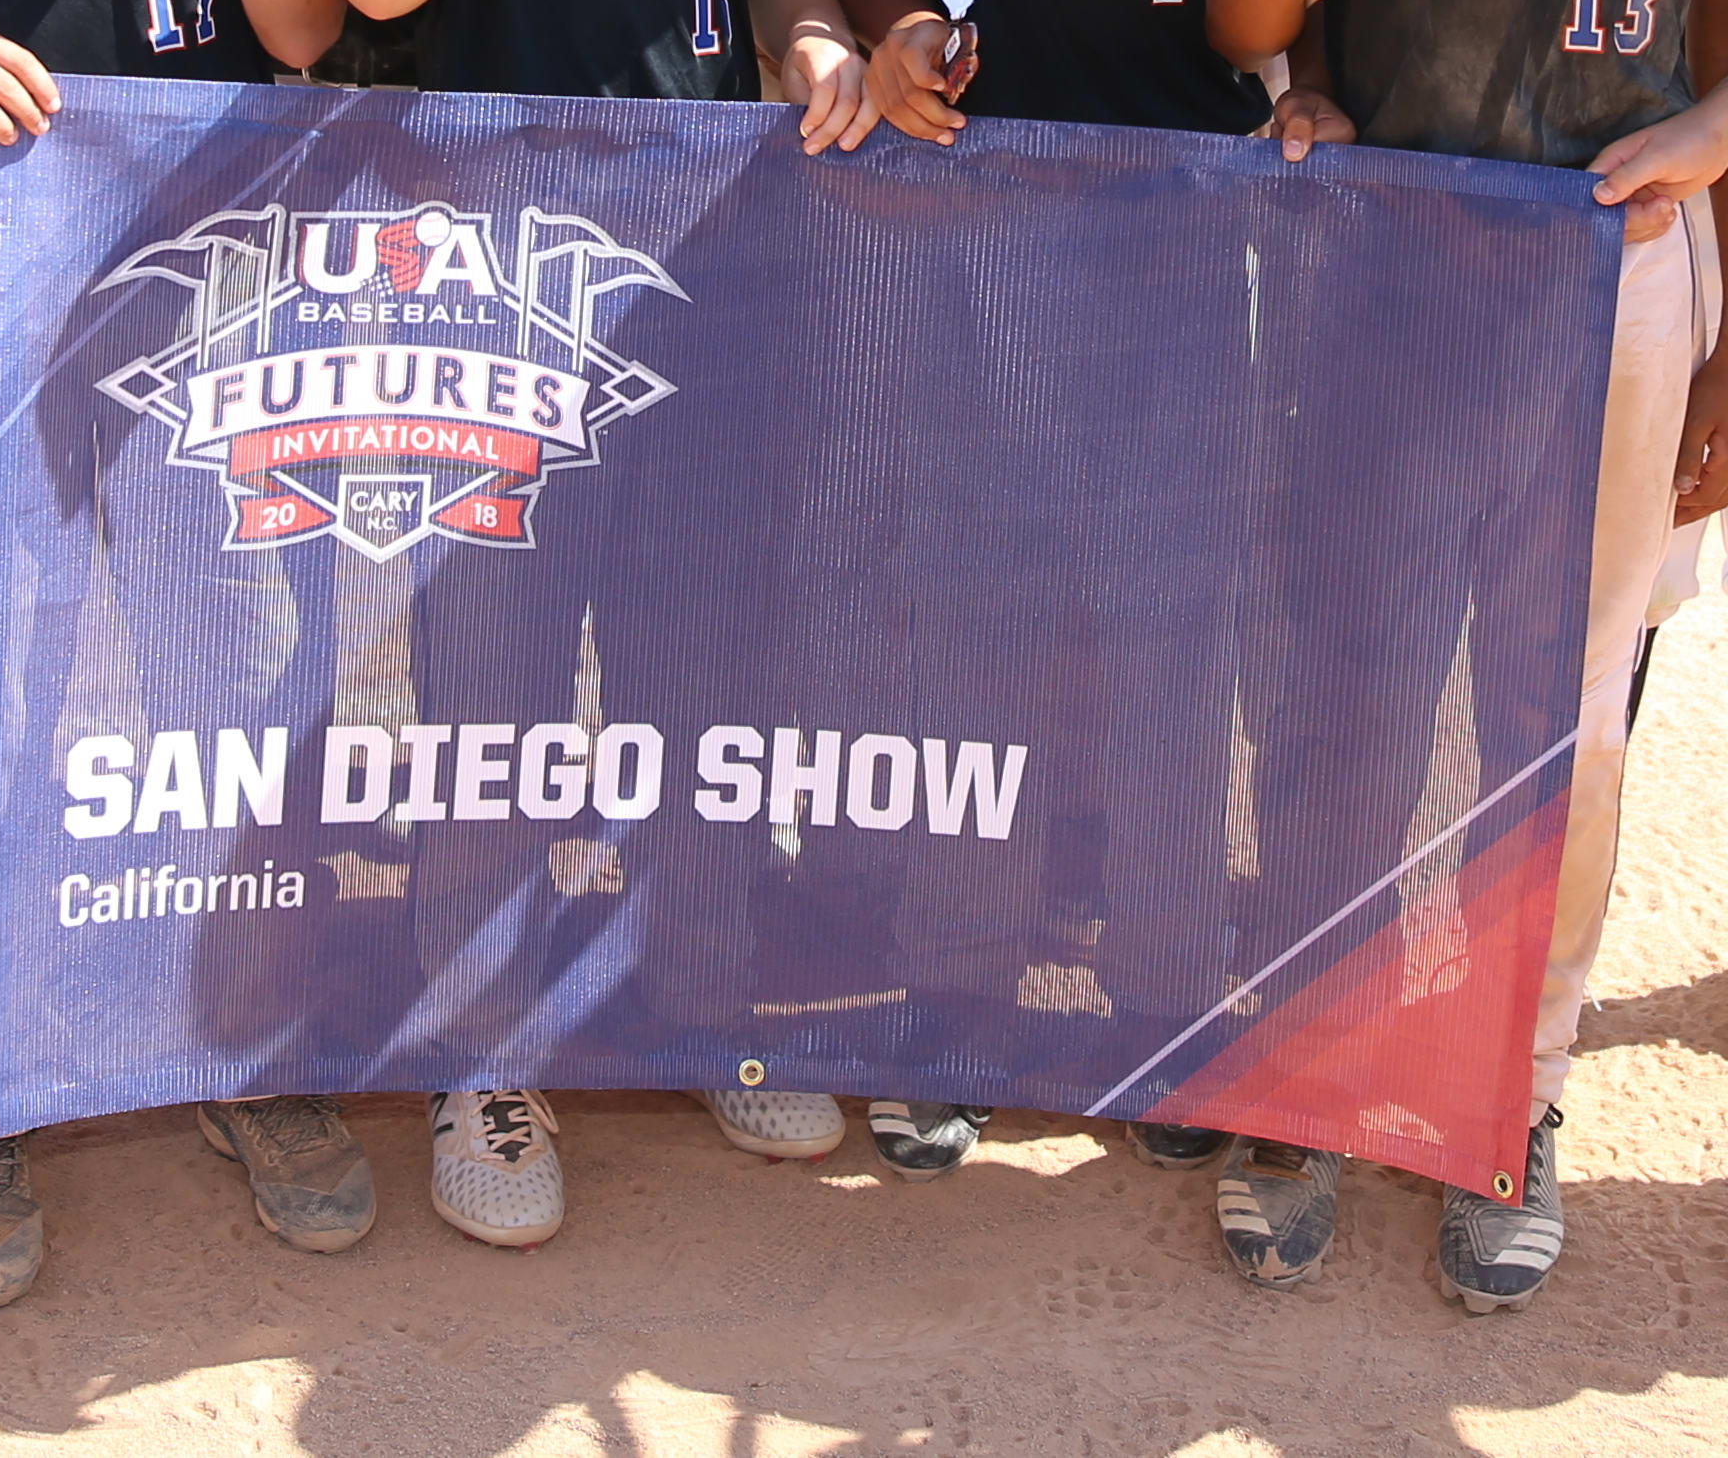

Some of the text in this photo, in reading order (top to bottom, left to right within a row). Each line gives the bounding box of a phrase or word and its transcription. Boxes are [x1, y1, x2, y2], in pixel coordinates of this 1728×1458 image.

[300, 211, 498, 297] USA
[297, 301, 497, 324] BASEBALL
[209, 352, 564, 432] FUTURES
[272, 424, 500, 461] INVITATIONAL
[261, 502, 297, 529] 20
[350, 491, 418, 513] CARY
[473, 502, 499, 529] 18
[367, 516, 399, 531] N.C.
[63, 723, 1028, 841] SAN DIEGO SHOW
[57, 861, 305, 929] California
